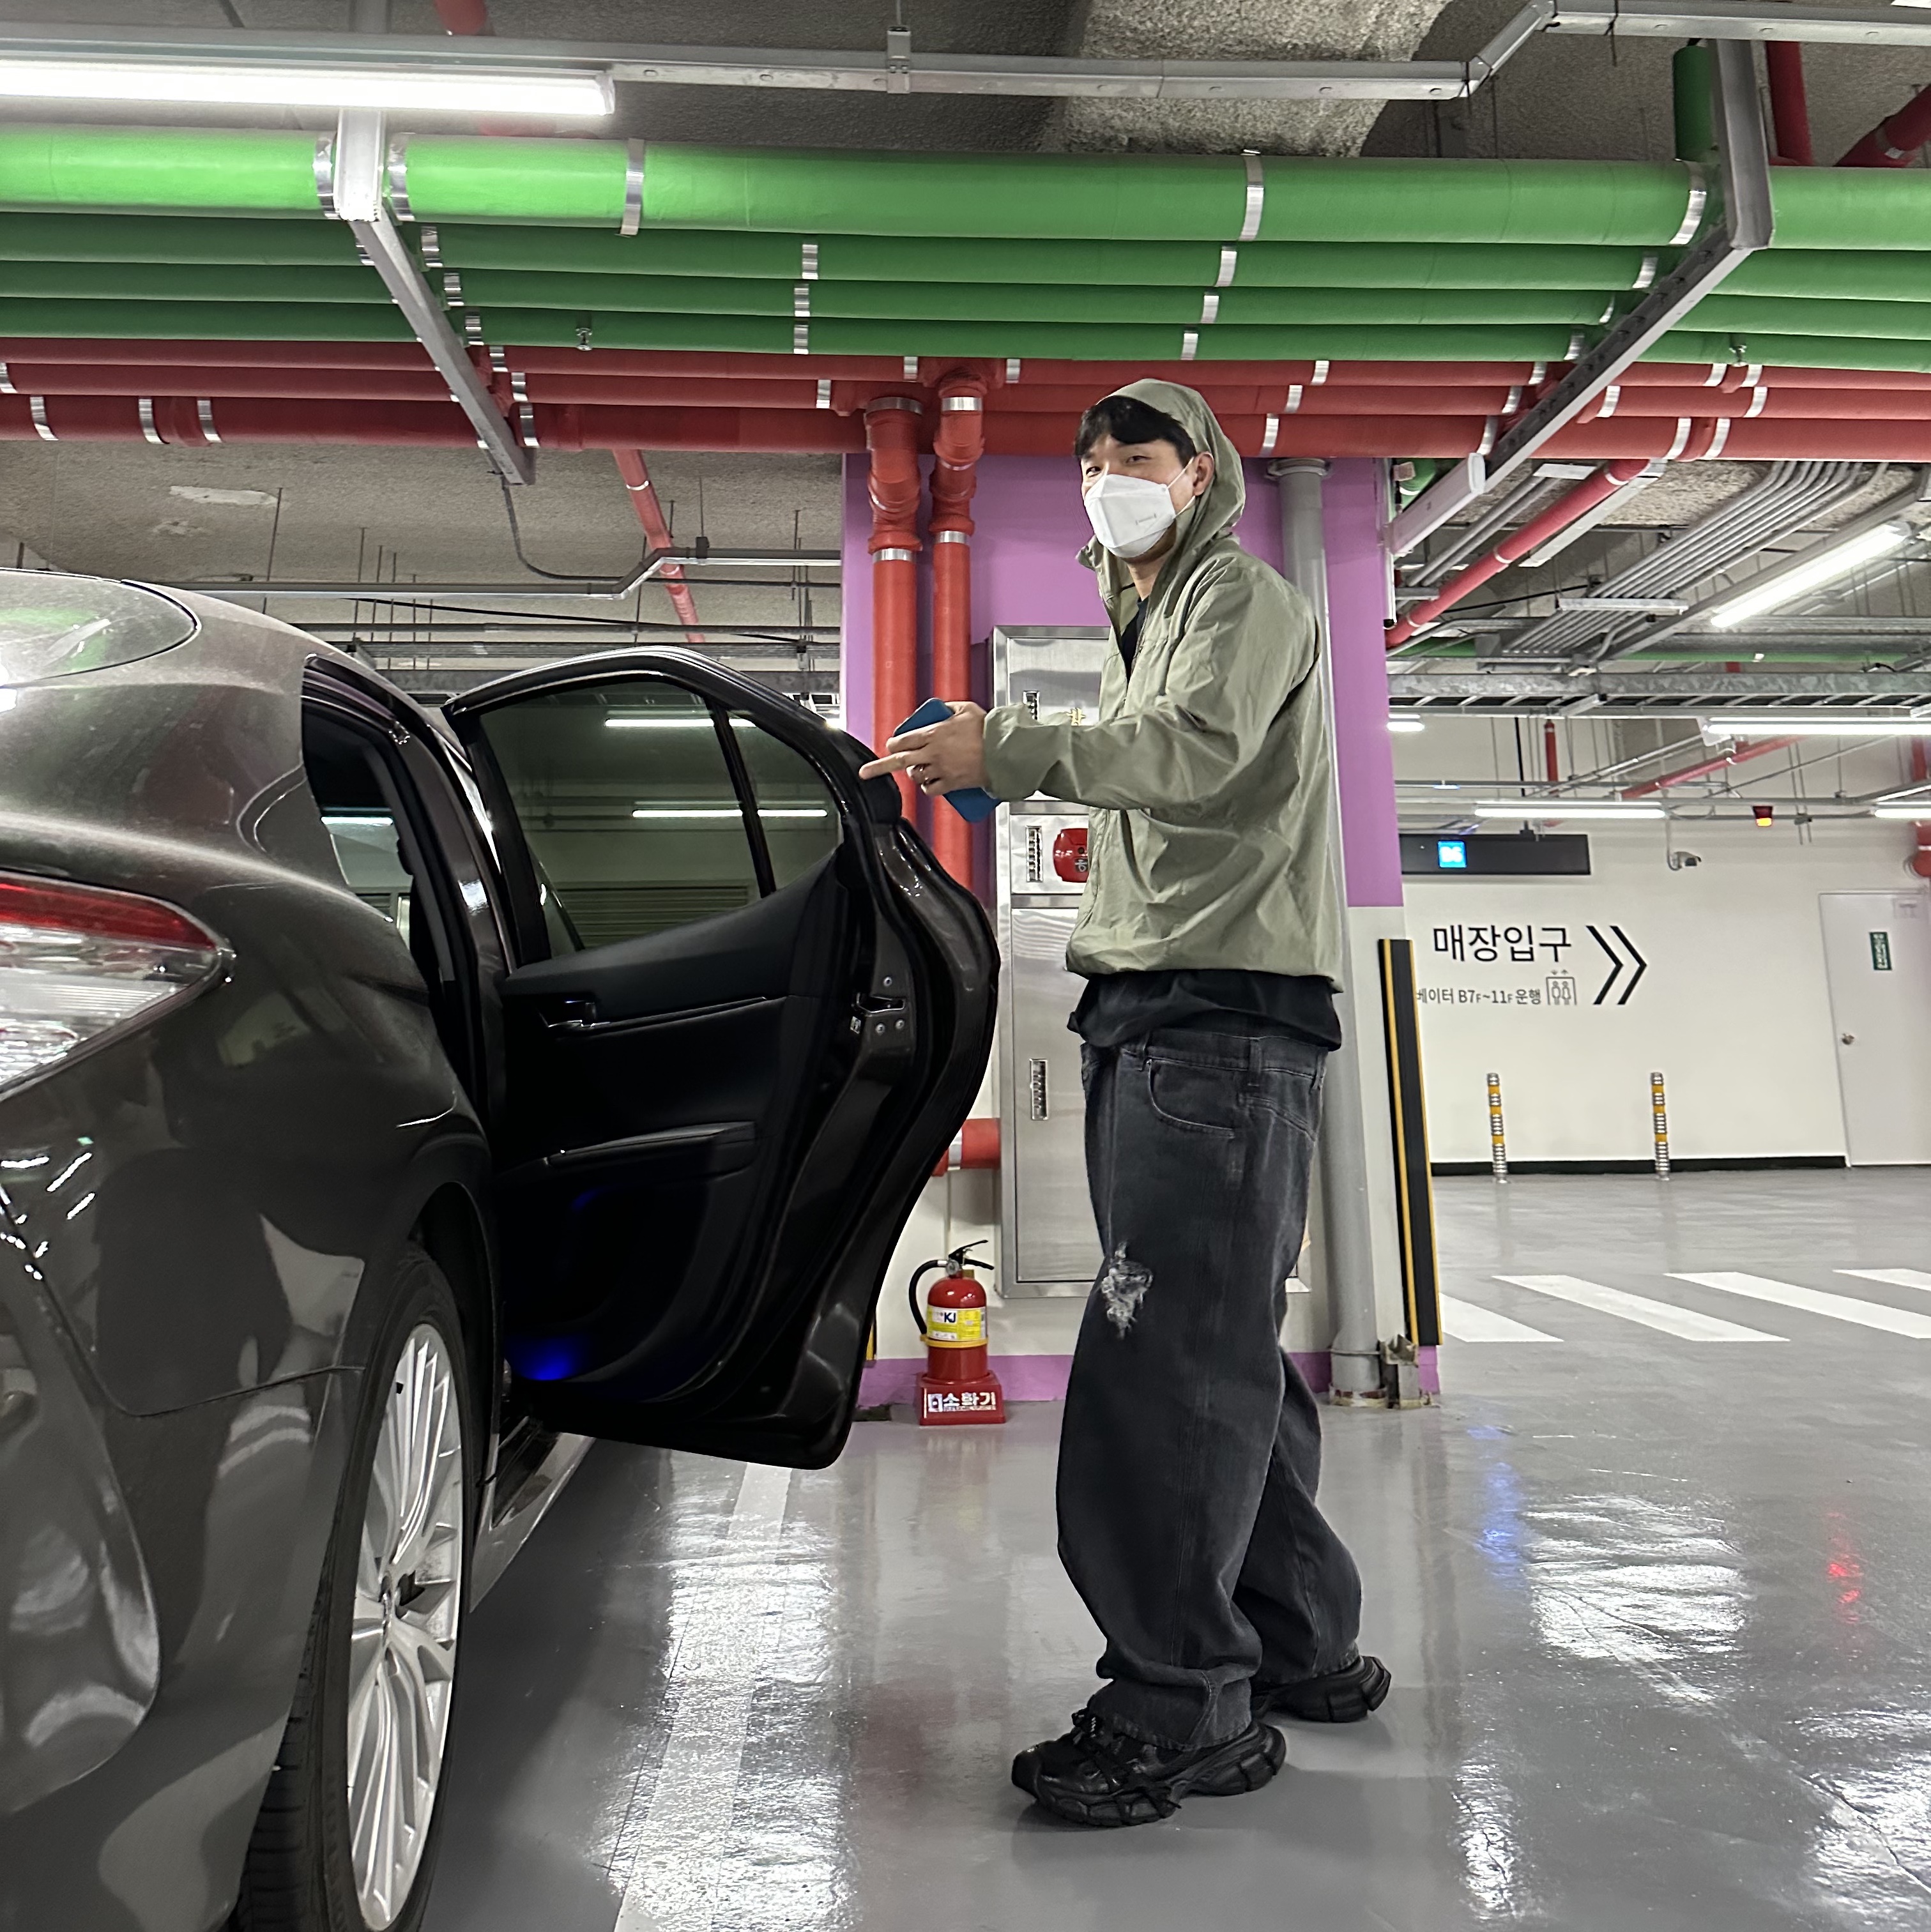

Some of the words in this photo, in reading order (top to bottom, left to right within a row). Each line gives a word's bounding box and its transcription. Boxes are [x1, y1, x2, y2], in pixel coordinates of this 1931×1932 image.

[1433, 924, 1571, 962] 매장입구
[1515, 989, 1541, 1005] 운행
[944, 1312, 956, 1323] KJ
[943, 1392, 996, 1407] 소화기
